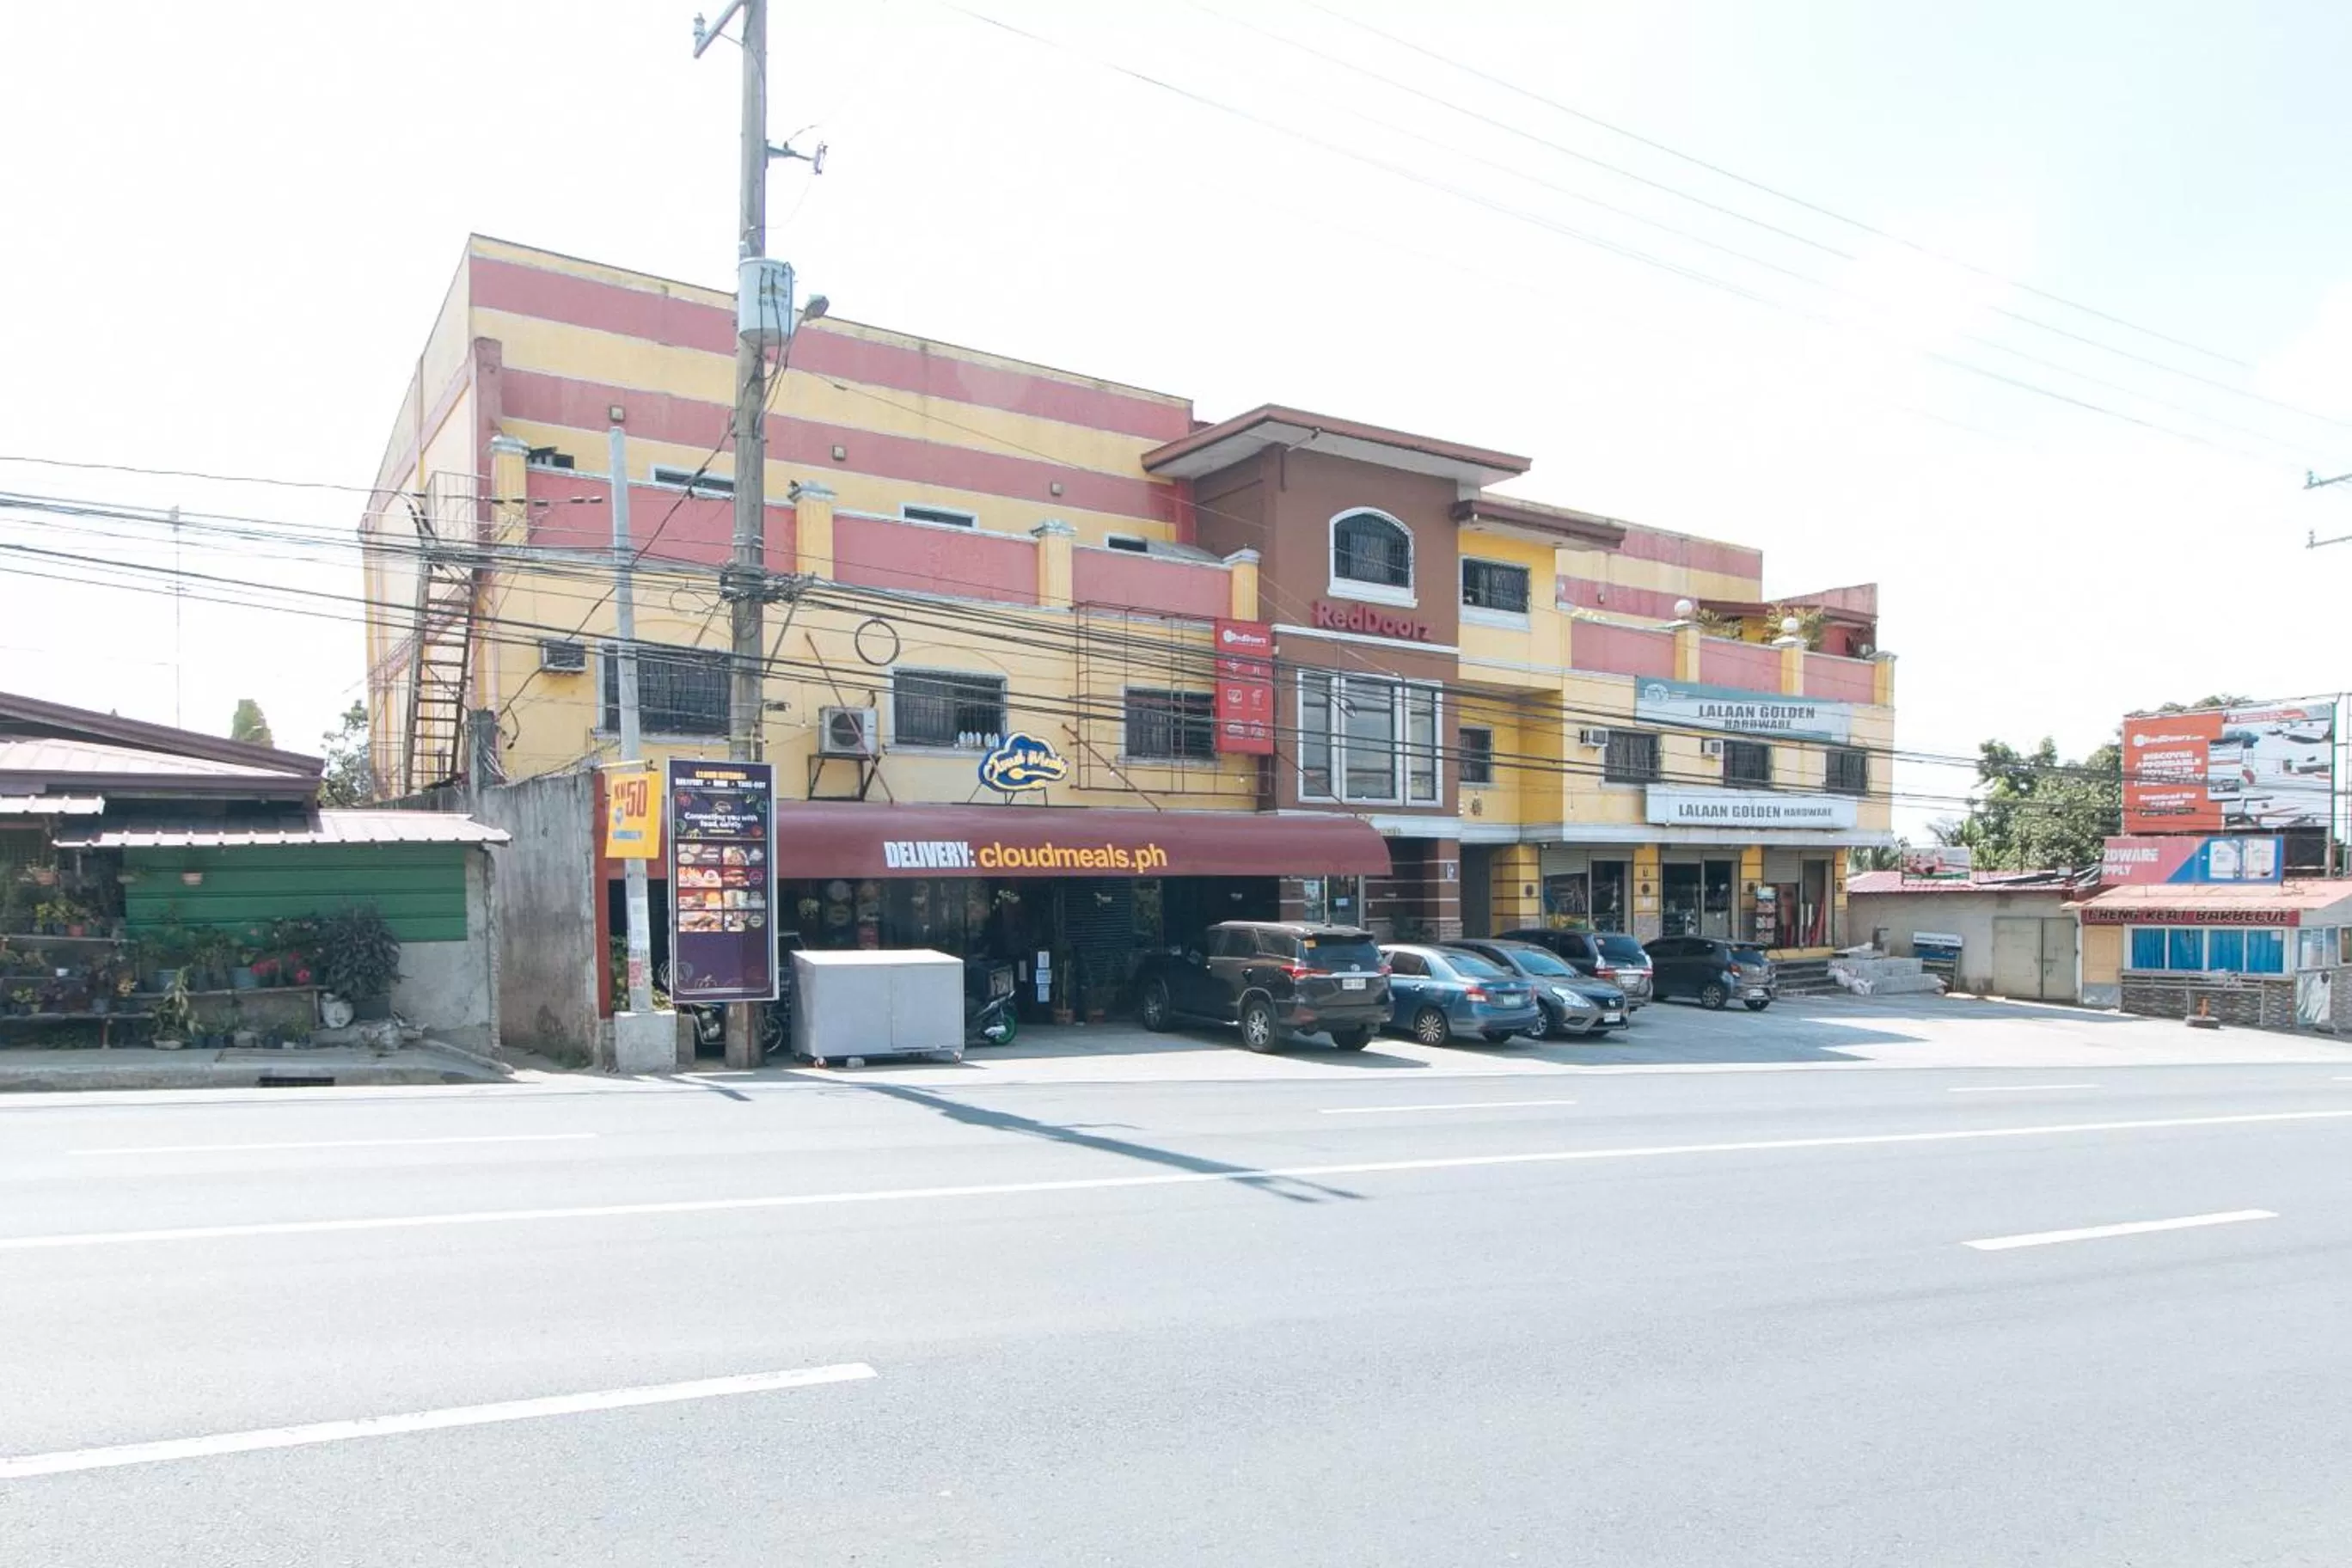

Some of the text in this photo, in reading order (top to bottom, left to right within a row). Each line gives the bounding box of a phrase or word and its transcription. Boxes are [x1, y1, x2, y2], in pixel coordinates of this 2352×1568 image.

[1311, 600, 1431, 640] RedDoorz
[1699, 704, 1816, 719] LALAAN GOLDEN
[626, 779, 648, 818] 50
[1679, 804, 1728, 818] LALAAN
[1732, 805, 1780, 818] GOLDEN
[884, 841, 1167, 873] DELIVERY: cloudmeals.ph
